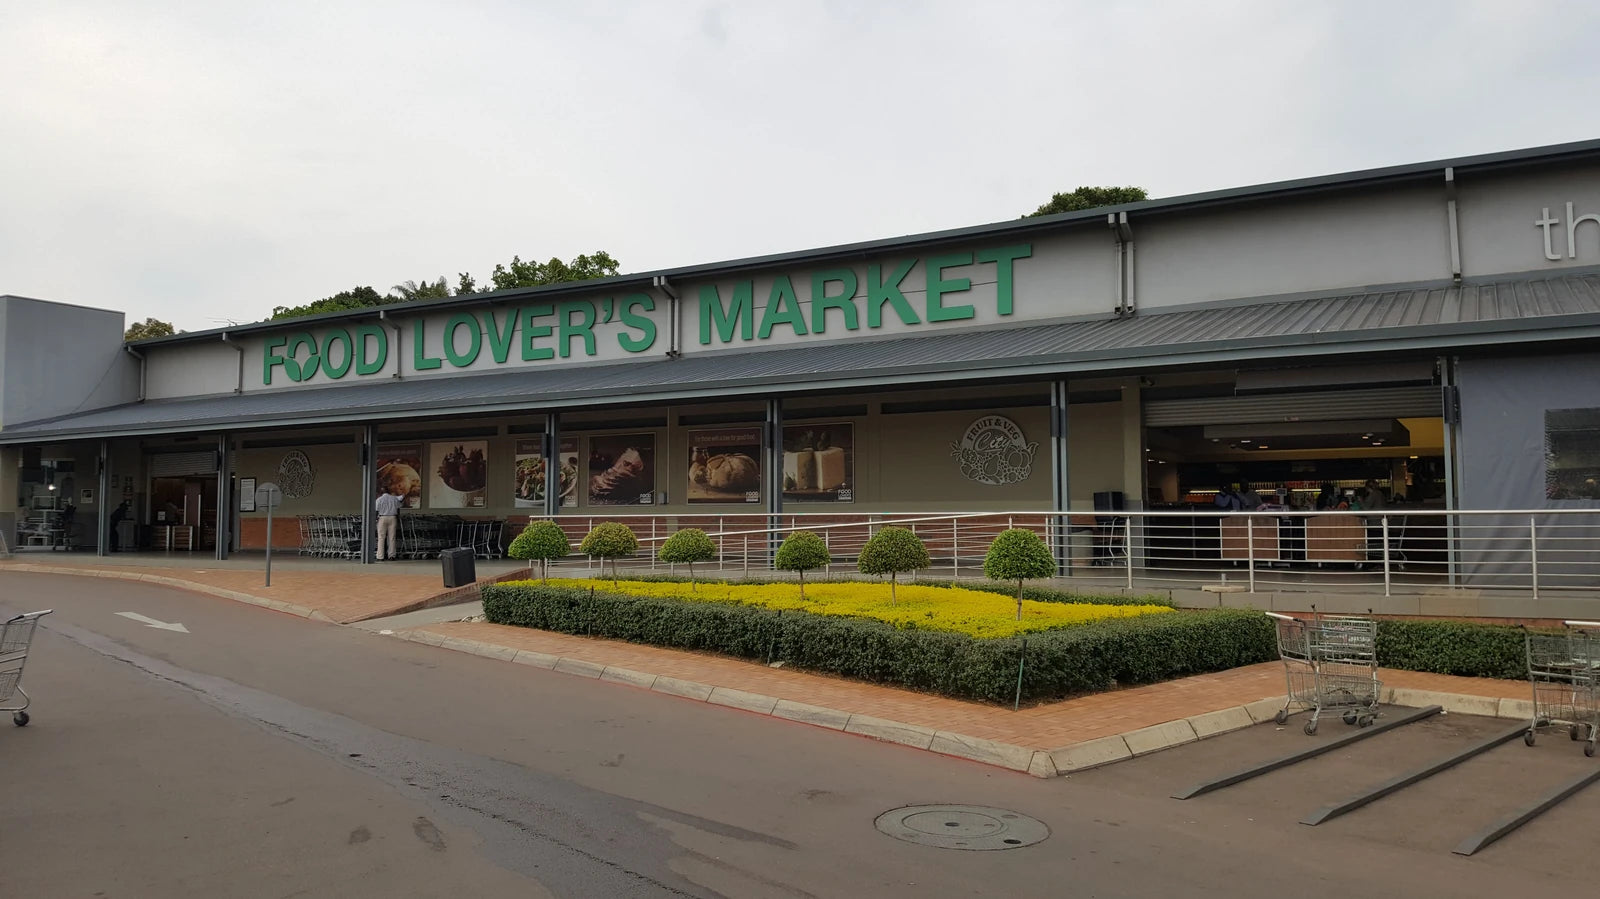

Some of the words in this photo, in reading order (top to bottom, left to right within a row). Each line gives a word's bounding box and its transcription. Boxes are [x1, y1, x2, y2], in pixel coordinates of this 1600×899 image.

[263, 323, 389, 386] FOOD
[413, 292, 657, 371] LOVER'S
[699, 244, 1032, 345] MARKET
[966, 419, 994, 441] FRUIT
[994, 418, 1002, 427] &
[1003, 421, 1021, 440] VEG
